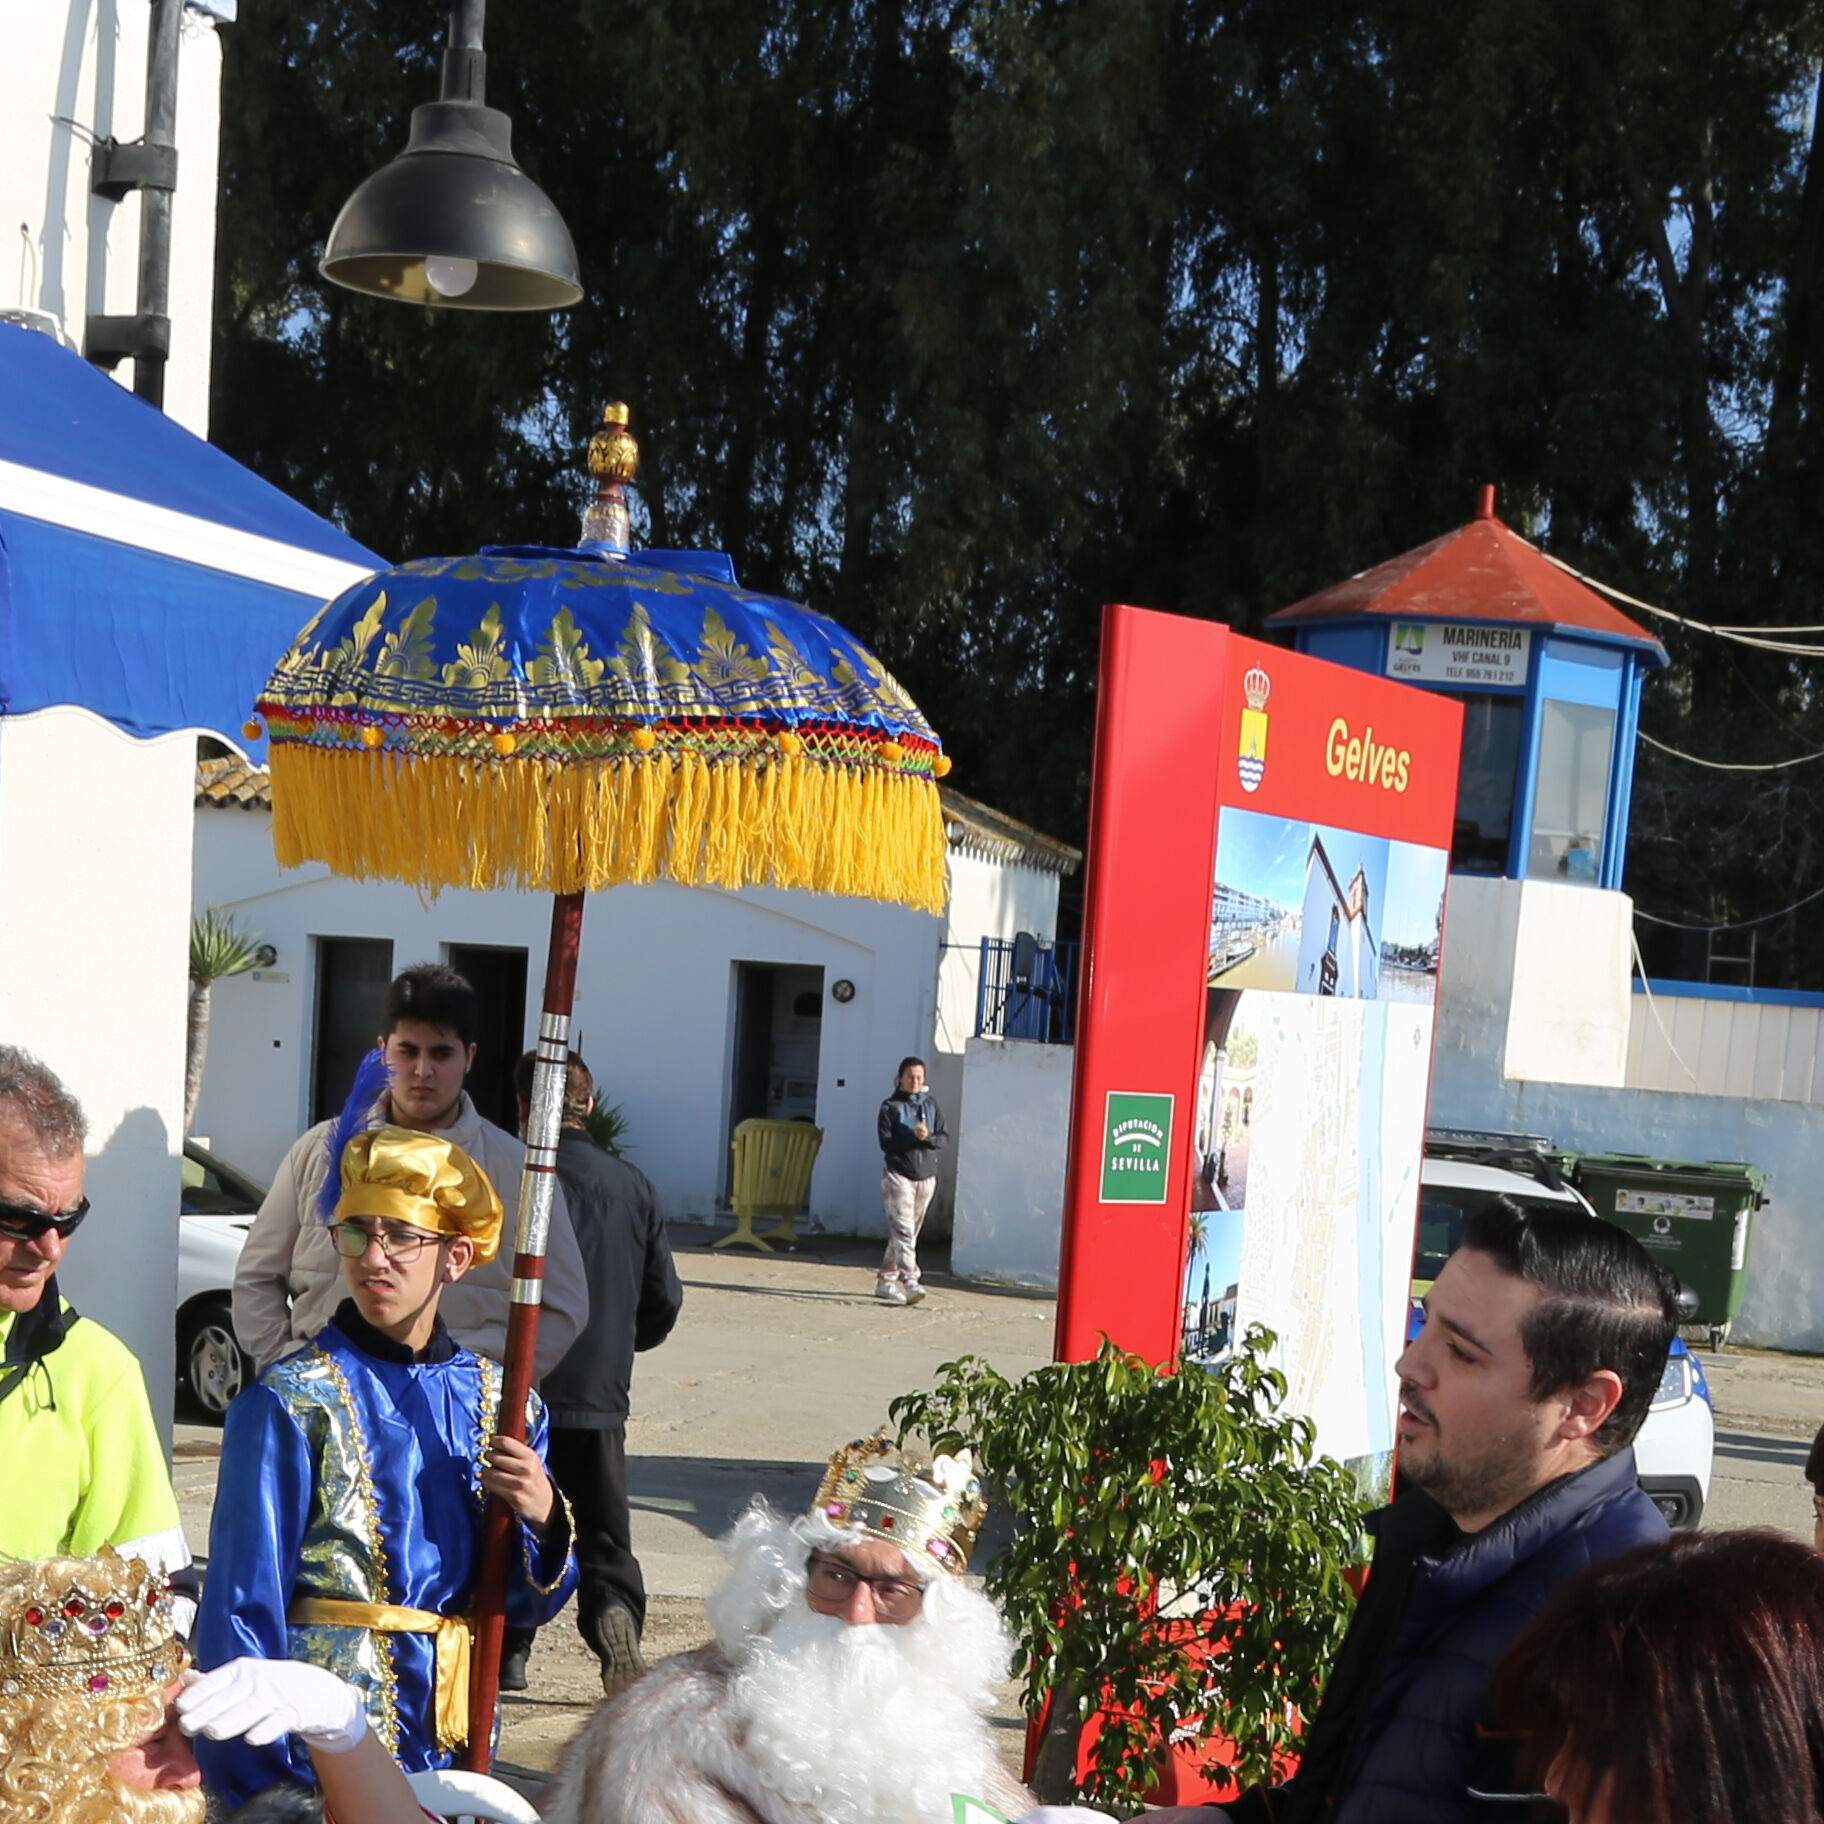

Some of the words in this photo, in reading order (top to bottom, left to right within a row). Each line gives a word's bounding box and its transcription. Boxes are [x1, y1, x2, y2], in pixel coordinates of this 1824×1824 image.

[1443, 627, 1522, 650] MARINERÍA
[1452, 651, 1469, 663] VHF
[1472, 652, 1502, 666] CANAL
[1326, 717, 1411, 792] Gelves
[1132, 1143, 1142, 1153] DE
[1111, 1157, 1160, 1172] SEVILLA
